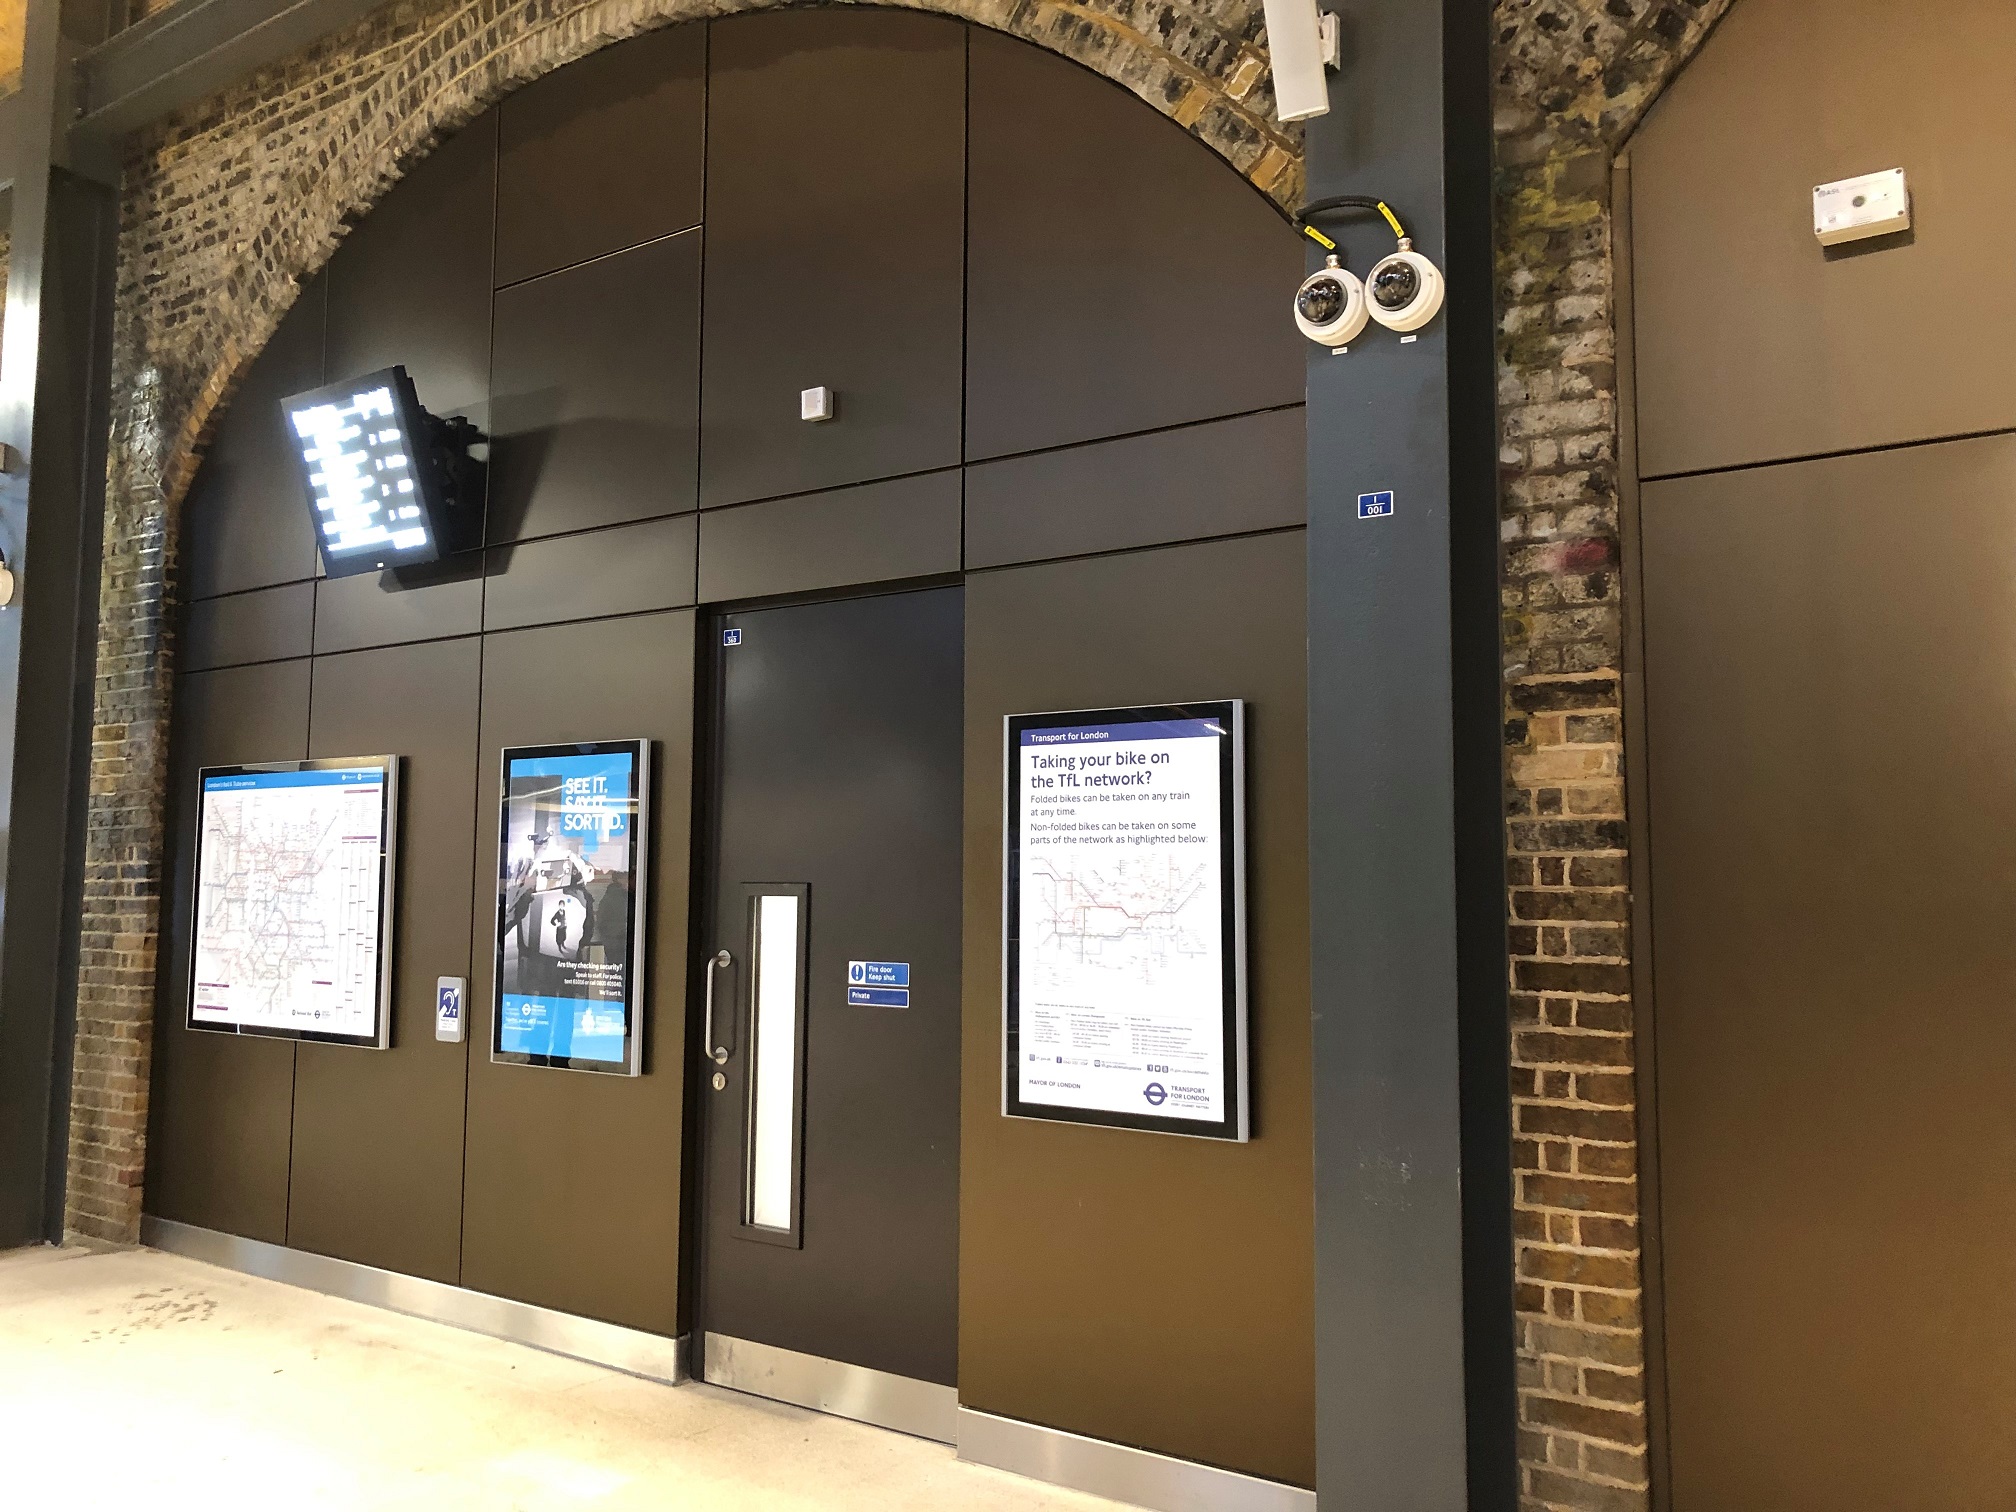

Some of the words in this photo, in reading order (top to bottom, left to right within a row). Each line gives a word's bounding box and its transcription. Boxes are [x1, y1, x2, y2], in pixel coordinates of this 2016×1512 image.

[1031, 733, 1066, 743] Transport
[1068, 732, 1079, 740] for
[1080, 730, 1109, 740] London
[1031, 754, 1075, 770] Taking
[1079, 755, 1111, 770] your
[1116, 750, 1146, 765] bike
[1150, 752, 1170, 764] on
[1030, 774, 1054, 788] the
[1057, 773, 1080, 787] TfL
[1084, 770, 1152, 787] network?
[565, 777, 591, 795] SEE
[592, 776, 608, 794] IT.
[1030, 794, 1058, 804] Folded
[1060, 794, 1081, 803] bikes
[1099, 793, 1110, 802] be
[1112, 792, 1136, 802] taken
[1138, 793, 1150, 801] on
[1151, 793, 1167, 803] any
[1169, 790, 1190, 800] train
[1030, 808, 1039, 817] at
[1040, 809, 1054, 818] any
[563, 813, 625, 831] SORTD.
[1030, 822, 1077, 832] Non-folded
[1078, 821, 1100, 831] bikes
[1101, 823, 1117, 831] can
[1118, 821, 1129, 831] be
[1131, 821, 1156, 830] taken
[1157, 822, 1169, 830] on
[1171, 822, 1197, 830] some
[1030, 836, 1051, 846] parts
[1052, 835, 1062, 844] of
[1063, 835, 1077, 844] the
[1079, 834, 1114, 844] network
[1115, 836, 1125, 844] as
[1127, 834, 1176, 846] highlighted
[557, 960, 566, 968] Are
[566, 961, 577, 970] they
[868, 965, 879, 973] Fire
[868, 973, 882, 981] Keep
[852, 991, 870, 999] Private
[1171, 1085, 1205, 1094] TRANSPORT
[1183, 1094, 1210, 1102] LONDON
